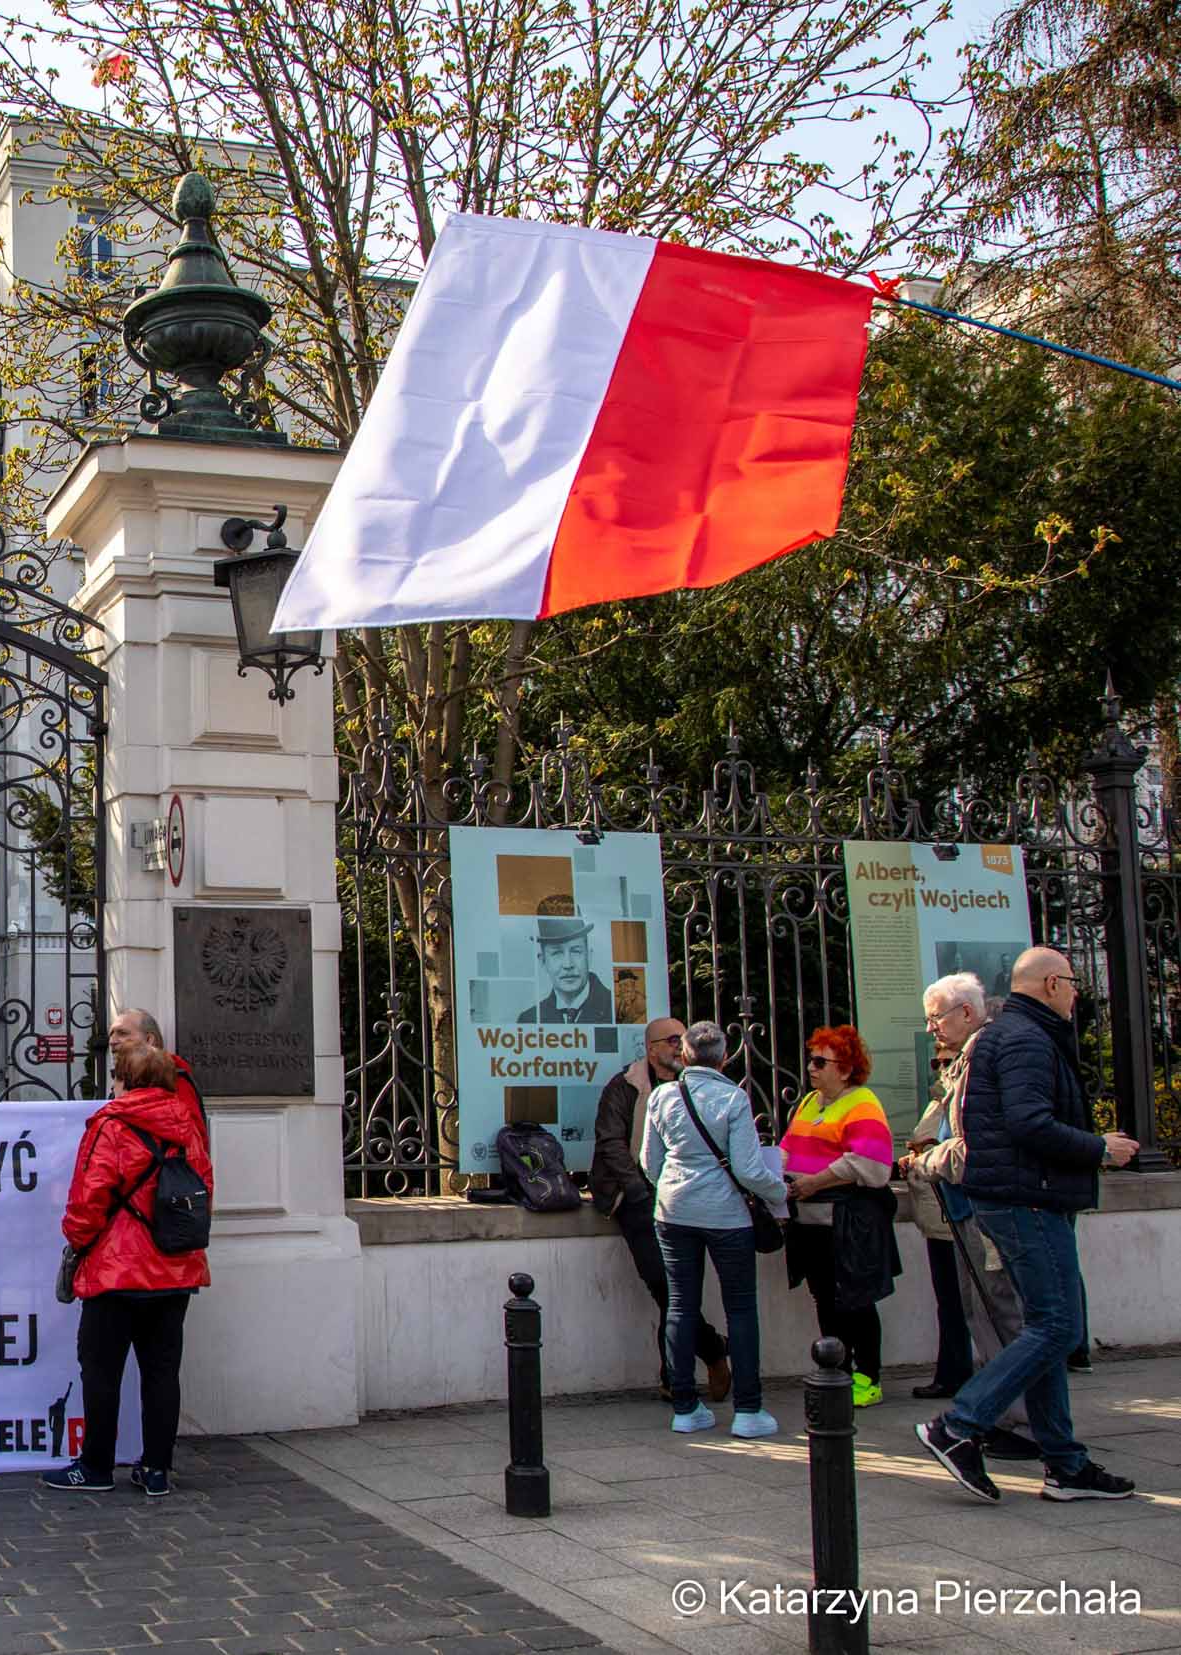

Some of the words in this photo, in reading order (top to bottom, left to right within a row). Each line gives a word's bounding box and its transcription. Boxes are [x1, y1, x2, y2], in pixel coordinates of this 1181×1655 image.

[855, 862, 926, 884] Albert,
[869, 888, 915, 912] czyli
[920, 890, 1010, 913] Wojciech
[477, 1027, 588, 1055] Wojciech
[490, 1056, 598, 1082] Korfanty
